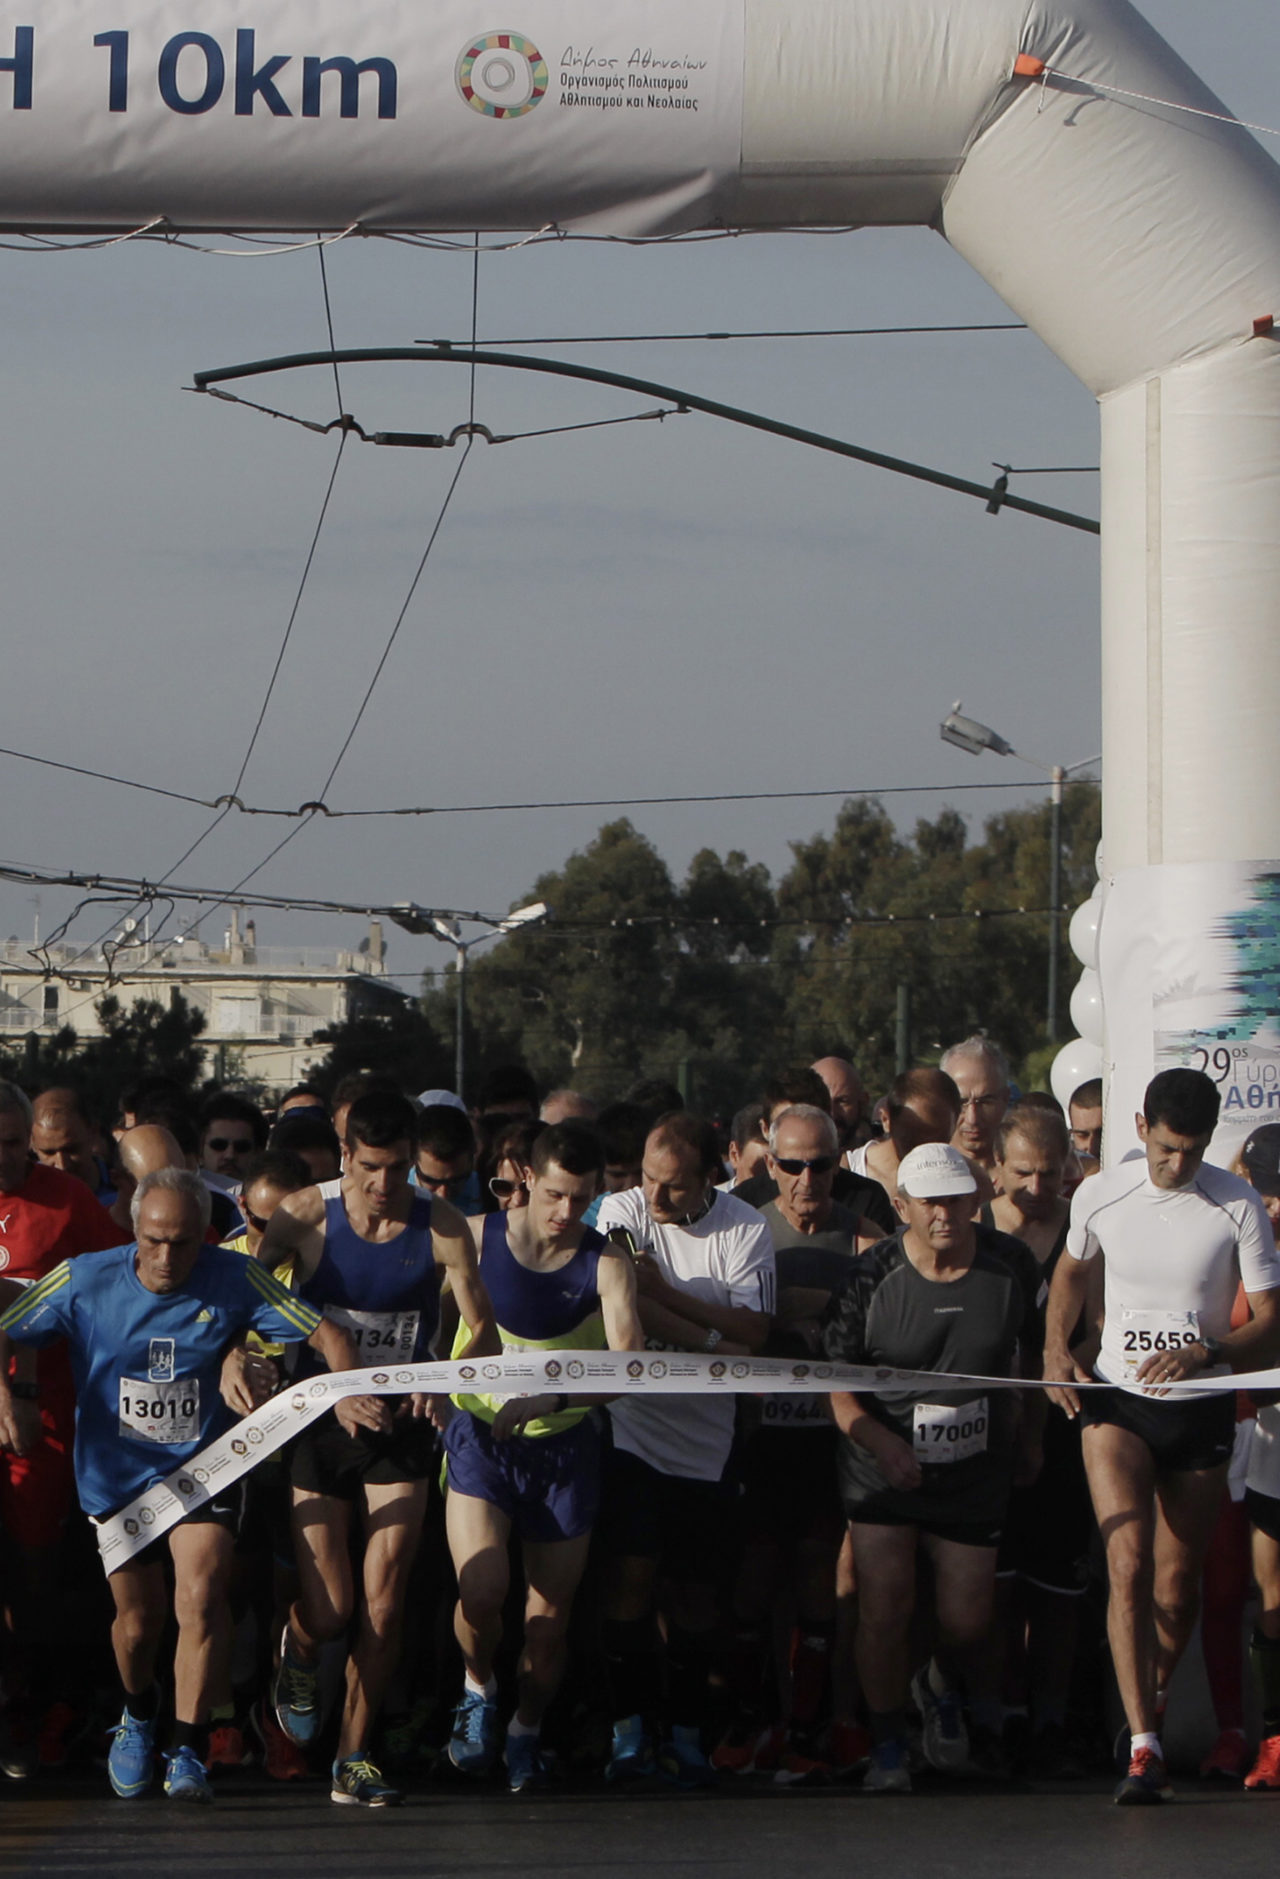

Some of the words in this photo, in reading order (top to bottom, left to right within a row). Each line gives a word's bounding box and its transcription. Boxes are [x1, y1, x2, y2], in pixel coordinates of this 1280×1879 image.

[93, 27, 398, 120] 10km
[626, 97, 644, 108] και
[354, 1328, 397, 1348] 134
[122, 1396, 196, 1419] 13010
[917, 1417, 986, 1442] 17000
